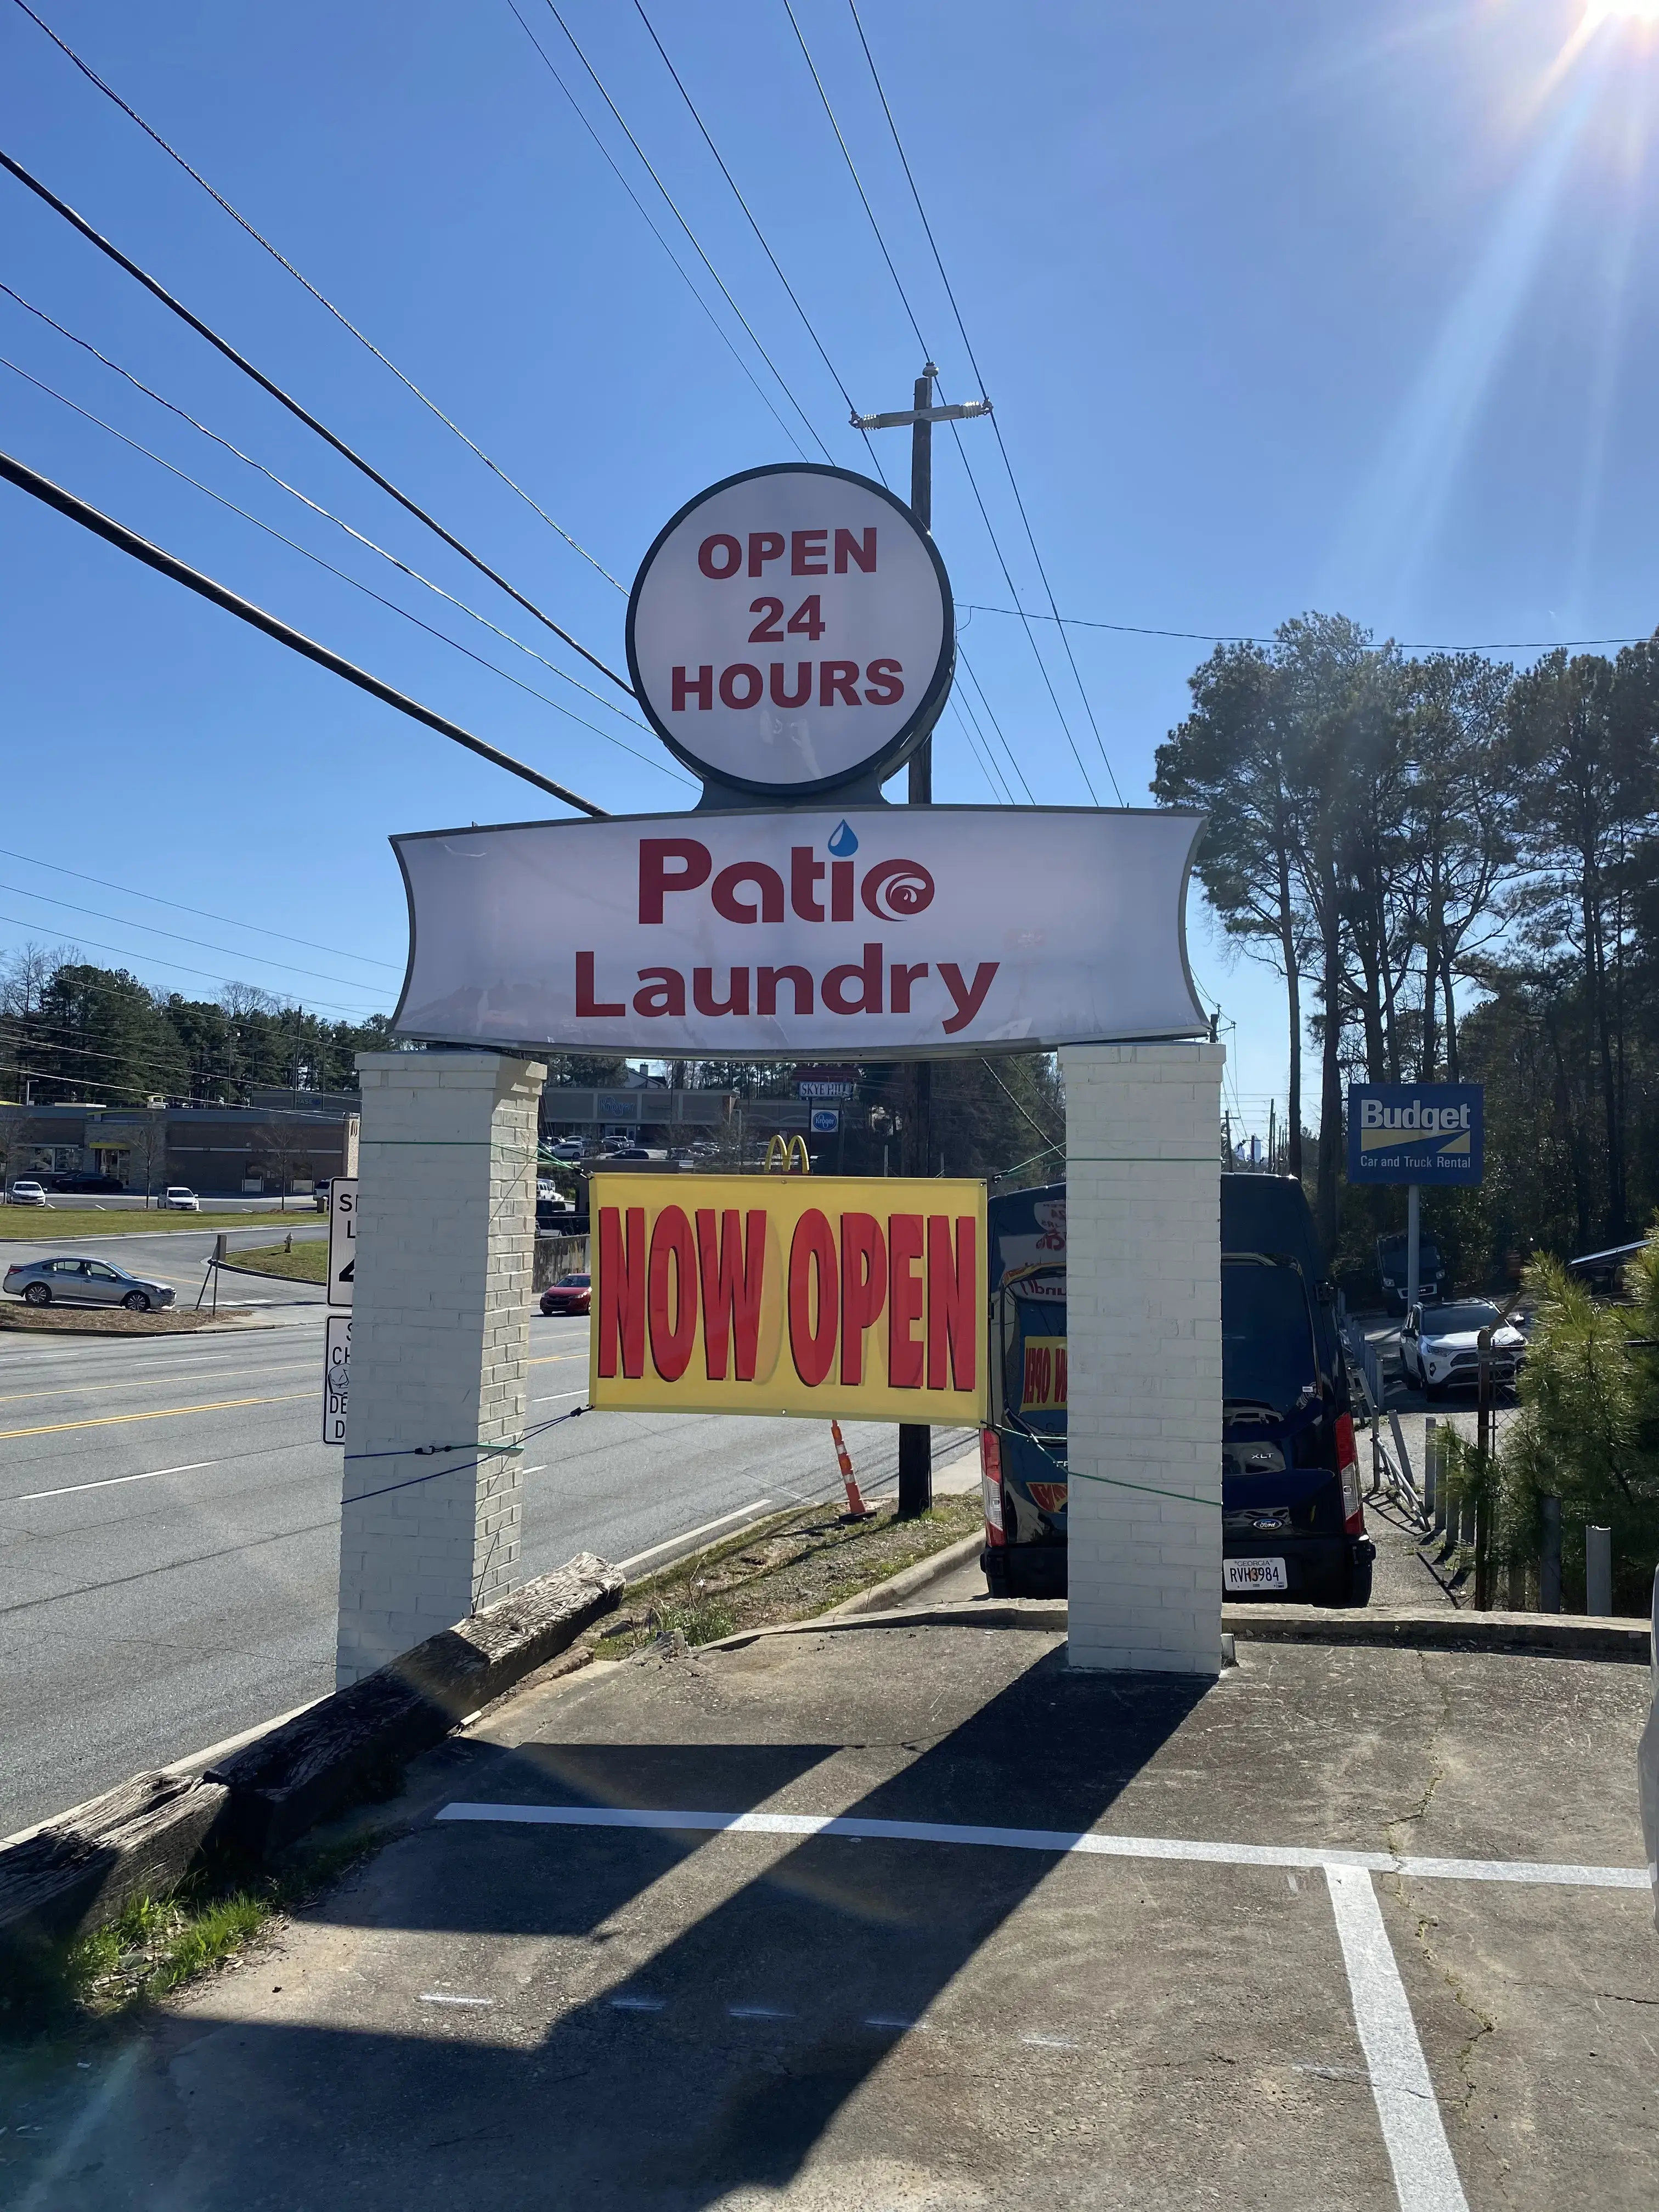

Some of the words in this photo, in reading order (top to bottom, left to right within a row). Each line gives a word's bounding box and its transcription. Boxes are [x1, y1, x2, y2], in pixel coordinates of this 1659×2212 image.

[698, 527, 877, 579] OPEN
[748, 595, 825, 643] 24
[672, 658, 904, 711] HOURS
[639, 820, 935, 924] Patio
[575, 943, 1001, 1035] Laundry
[802, 1083, 825, 1096] SKYE
[815, 1114, 834, 1128] Kroger
[1361, 1099, 1471, 1137] Budget
[1361, 1155, 1378, 1167] Car
[1381, 1156, 1400, 1167] and
[1403, 1156, 1432, 1167] Truck
[1437, 1156, 1471, 1168] Rental
[598, 1204, 767, 1383] NOW
[788, 1208, 976, 1392] OPEN
[1260, 1519, 1276, 1528] Ford
[1229, 1567, 1279, 1583] RVH3984
